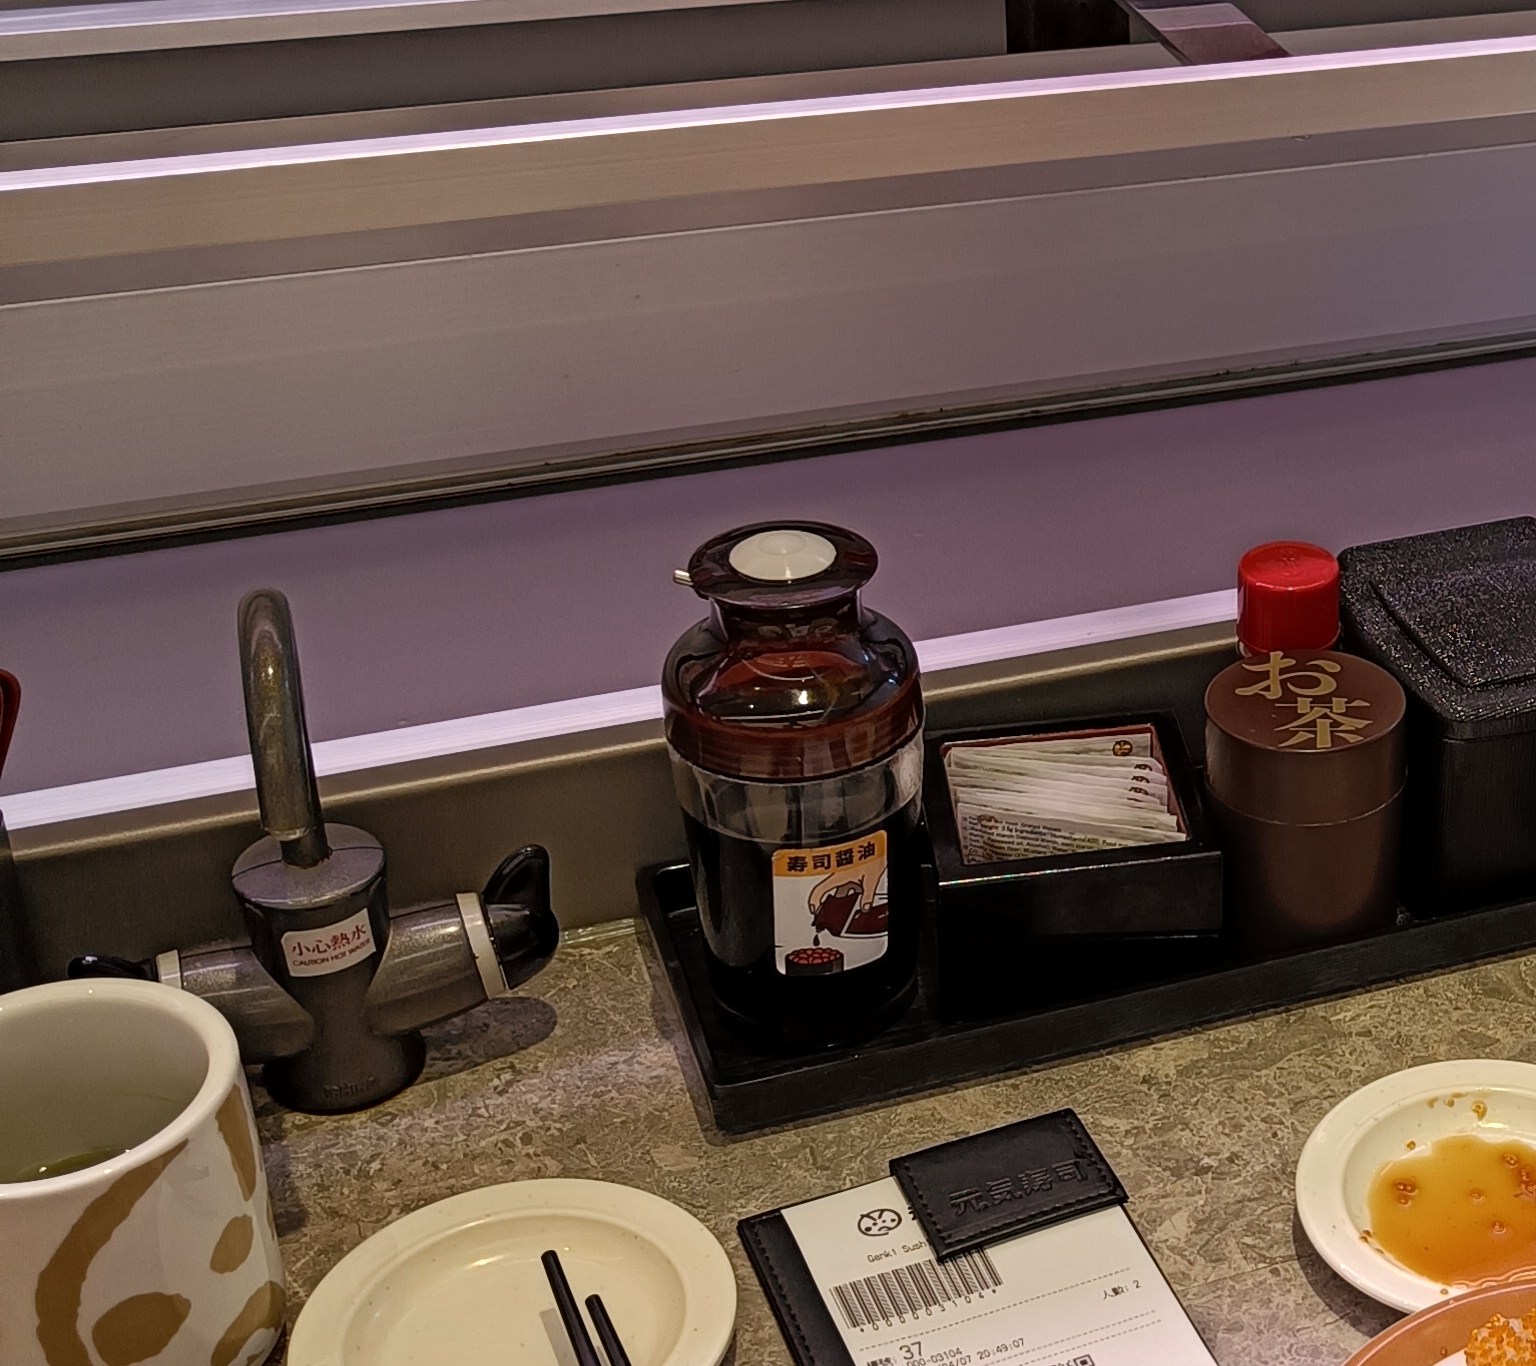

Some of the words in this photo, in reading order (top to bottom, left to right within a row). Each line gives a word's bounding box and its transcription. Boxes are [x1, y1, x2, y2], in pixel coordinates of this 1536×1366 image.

[1235, 651, 1372, 750] お茶
[292, 924, 367, 956] 小心熱水
[292, 957, 330, 967] CAUTION
[331, 952, 347, 961] HOT
[898, 1340, 927, 1360] 37
[975, 1336, 1027, 1360] 20:49:07
